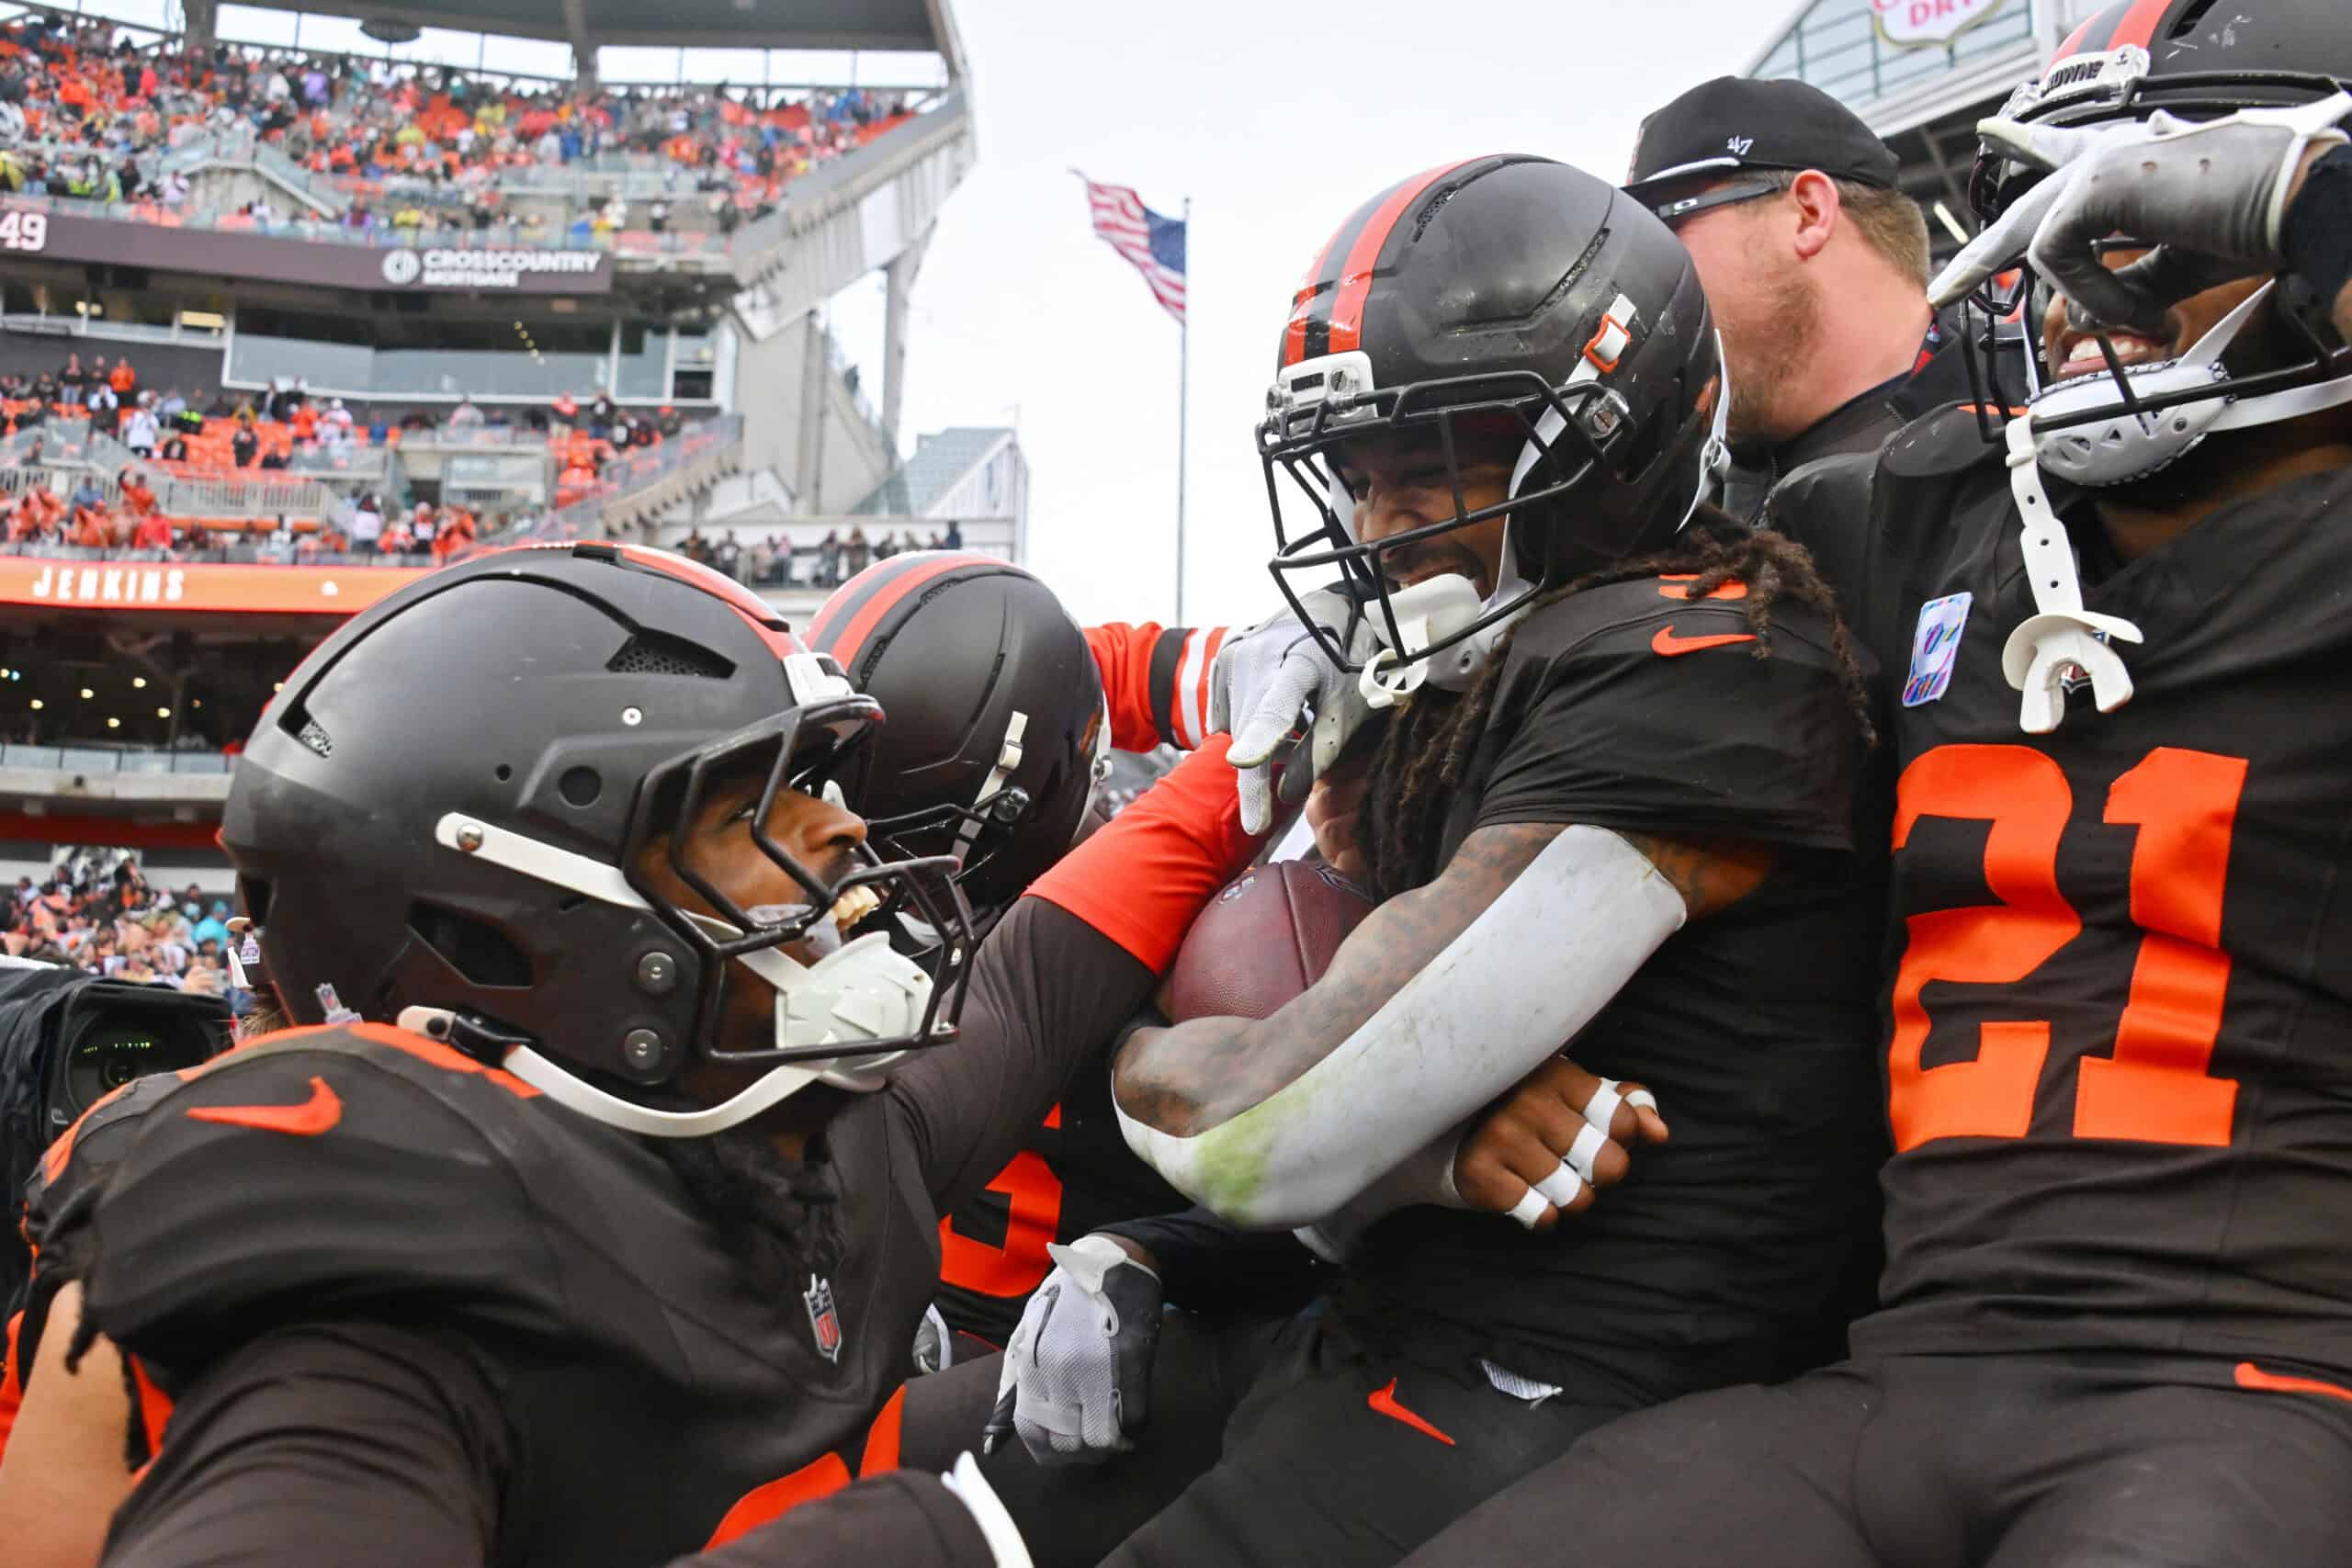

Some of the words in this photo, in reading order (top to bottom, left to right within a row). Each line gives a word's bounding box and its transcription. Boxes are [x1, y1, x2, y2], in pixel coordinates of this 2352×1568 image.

[423, 249, 603, 273] CROSSCOUNTRY
[32, 566, 184, 603] JENKINS
[1889, 744, 2249, 1154] 21
